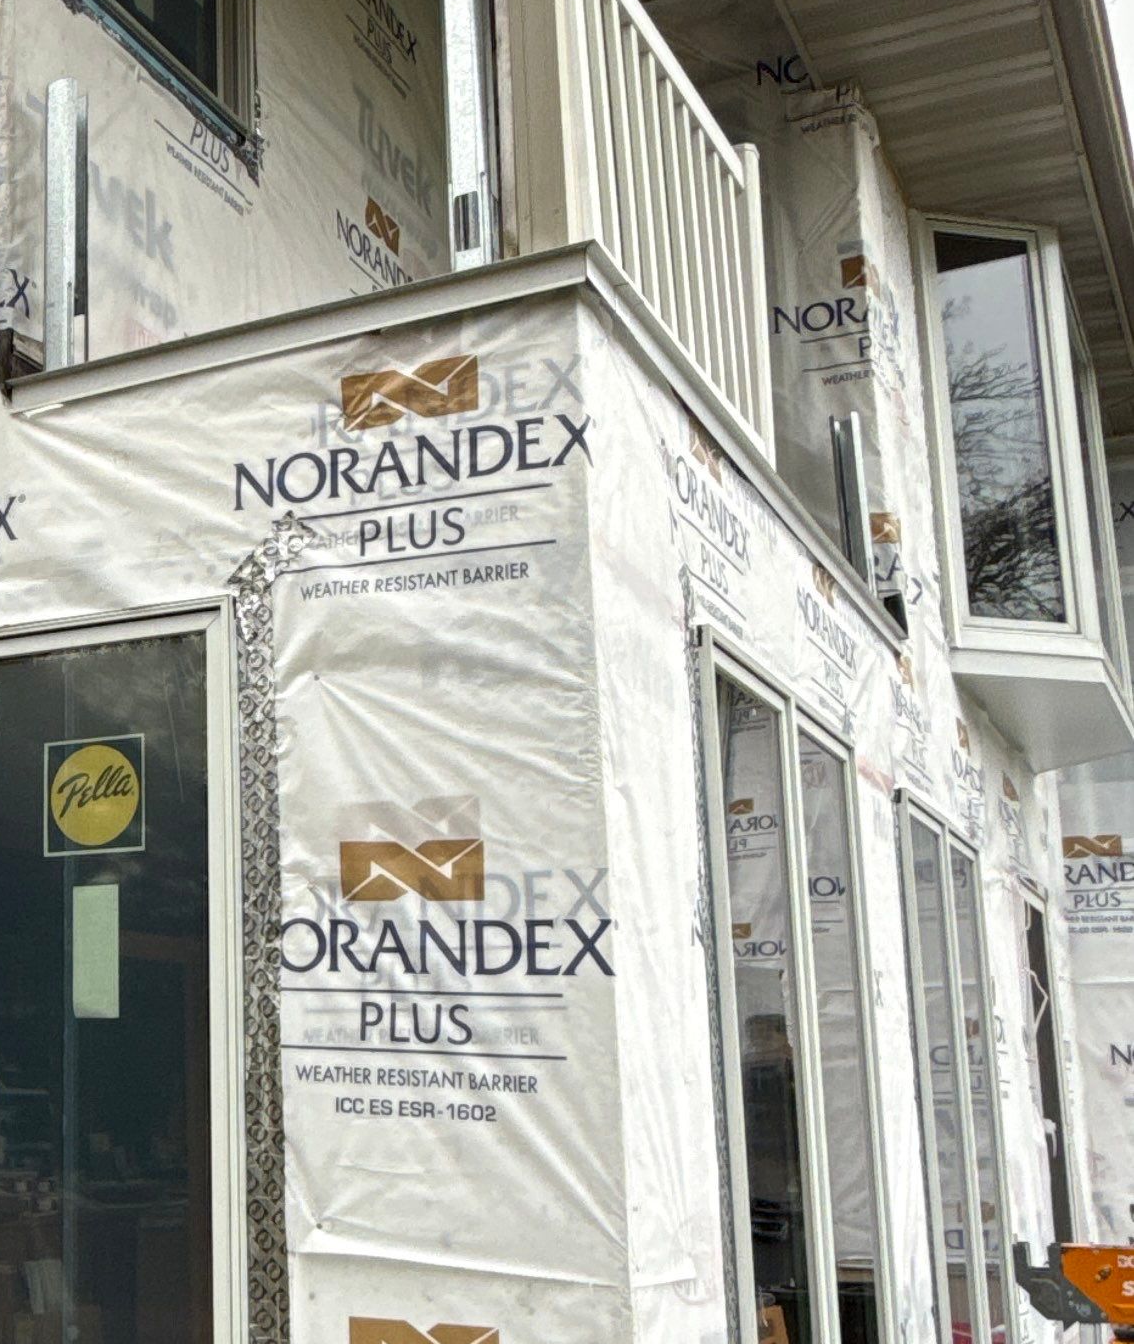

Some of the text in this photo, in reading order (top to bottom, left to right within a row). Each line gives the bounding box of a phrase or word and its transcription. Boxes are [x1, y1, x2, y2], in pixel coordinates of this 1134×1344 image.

[190, 121, 231, 174] PLUS
[234, 413, 594, 512] NORANDEX
[359, 506, 466, 558] PLUS
[300, 561, 530, 601] WEATHER RESISTANT BARRIER
[58, 765, 133, 819] Pella
[1074, 891, 1121, 908] PLUS
[280, 917, 616, 977] ORANDEX
[359, 1001, 474, 1046] PLUS
[295, 1064, 539, 1095] WEATHER RESISTANT BARRIER
[335, 1096, 365, 1115] ICC
[369, 1098, 393, 1116] ES
